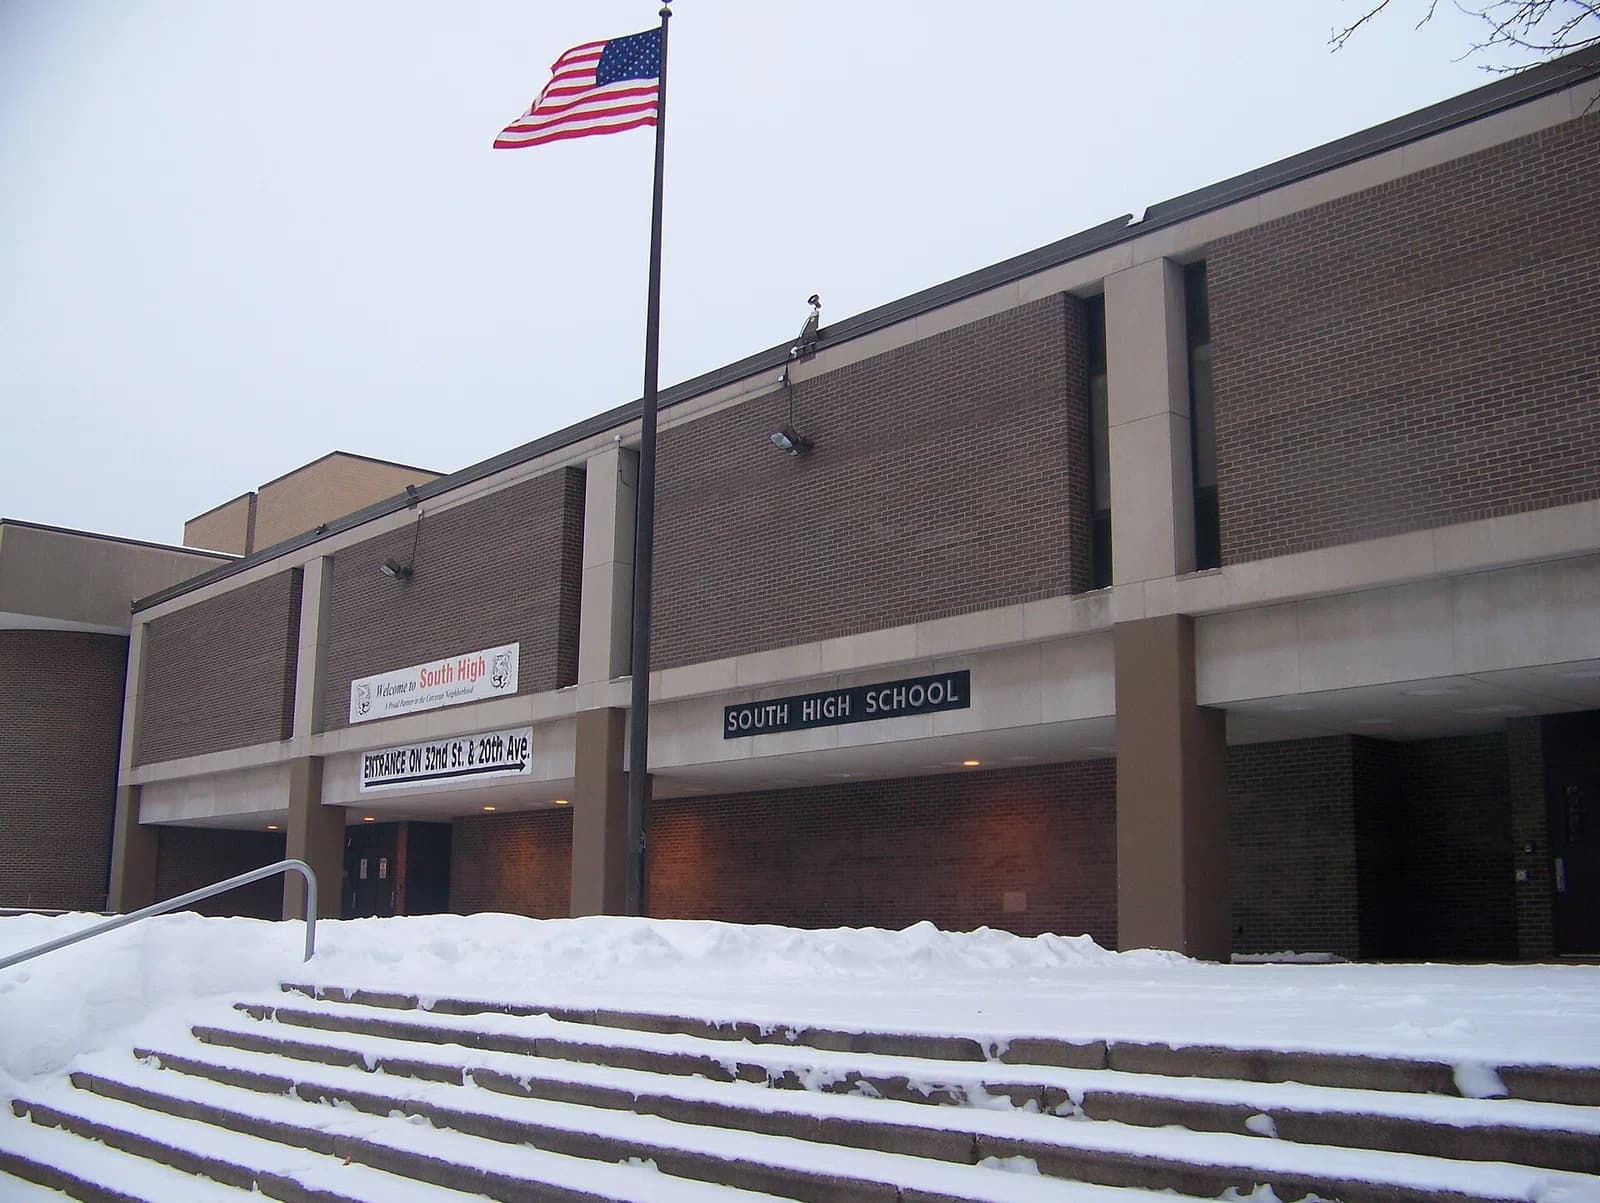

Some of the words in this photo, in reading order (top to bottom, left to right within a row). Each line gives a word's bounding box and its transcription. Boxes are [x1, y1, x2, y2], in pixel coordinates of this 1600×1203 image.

[376, 682, 407, 698] Welcome
[408, 680, 416, 692] to
[420, 663, 453, 689] South
[458, 656, 485, 683] High
[728, 704, 788, 732] SOUTH
[803, 695, 850, 722] HIGH
[866, 680, 959, 713] SCHOOL
[364, 750, 406, 779] ENTRANCE
[409, 748, 422, 773] ON
[425, 743, 448, 771] 32nd
[451, 741, 465, 768] St.
[468, 740, 474, 766] &
[478, 735, 503, 764] 20th
[506, 735, 531, 761] Ave.
